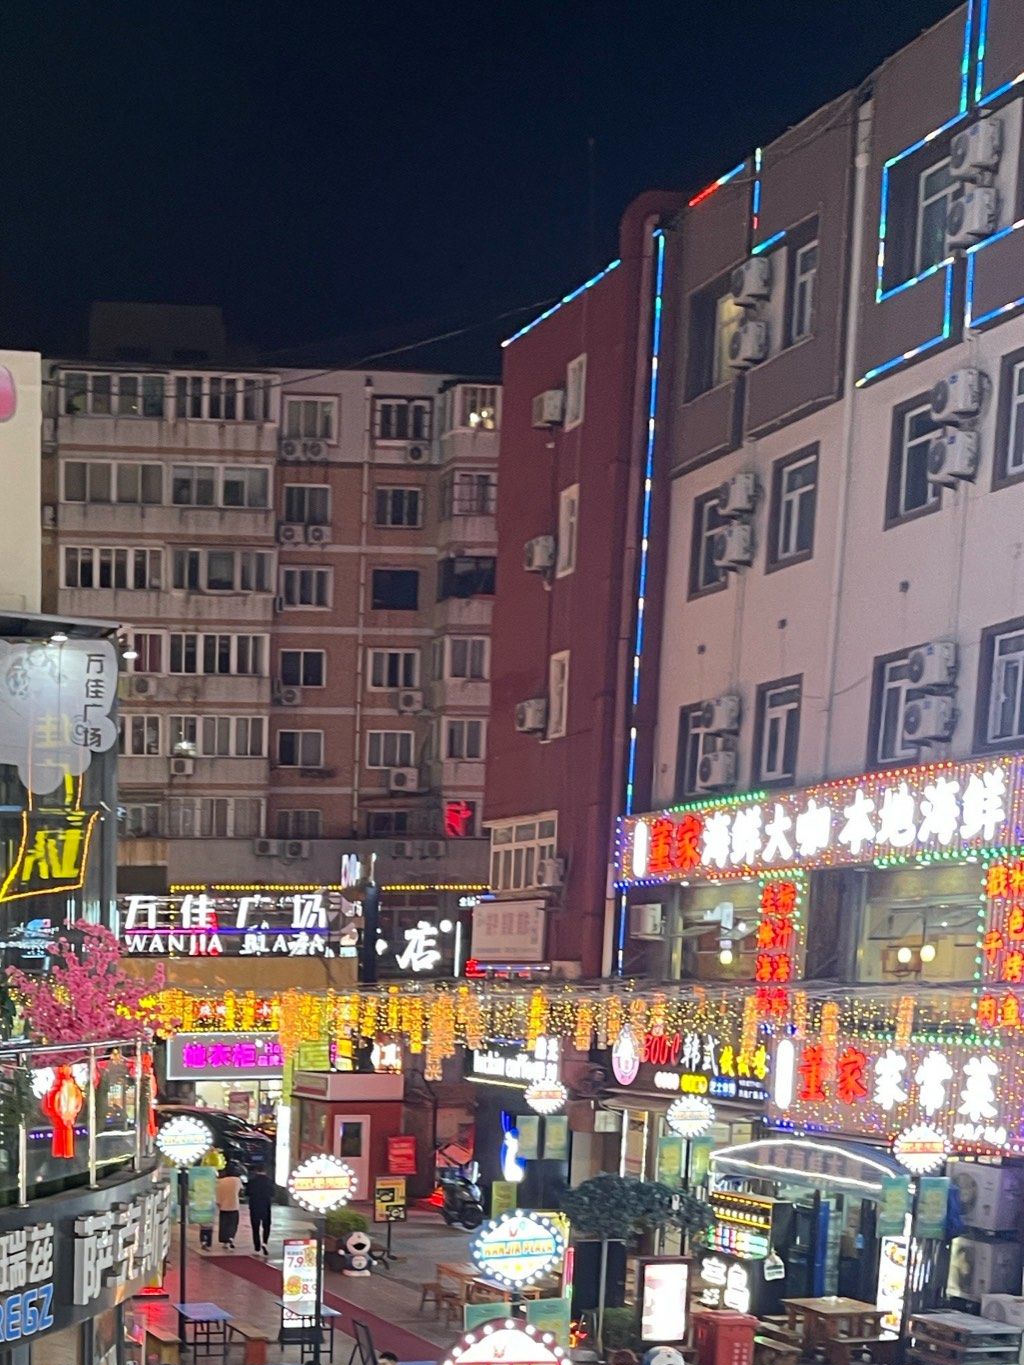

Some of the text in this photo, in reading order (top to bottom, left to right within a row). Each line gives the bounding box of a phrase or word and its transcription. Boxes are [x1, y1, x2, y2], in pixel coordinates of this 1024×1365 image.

[82, 652, 107, 748] 万佳广场
[124, 894, 328, 930] 万佳广场
[125, 934, 224, 956] WANJIA
